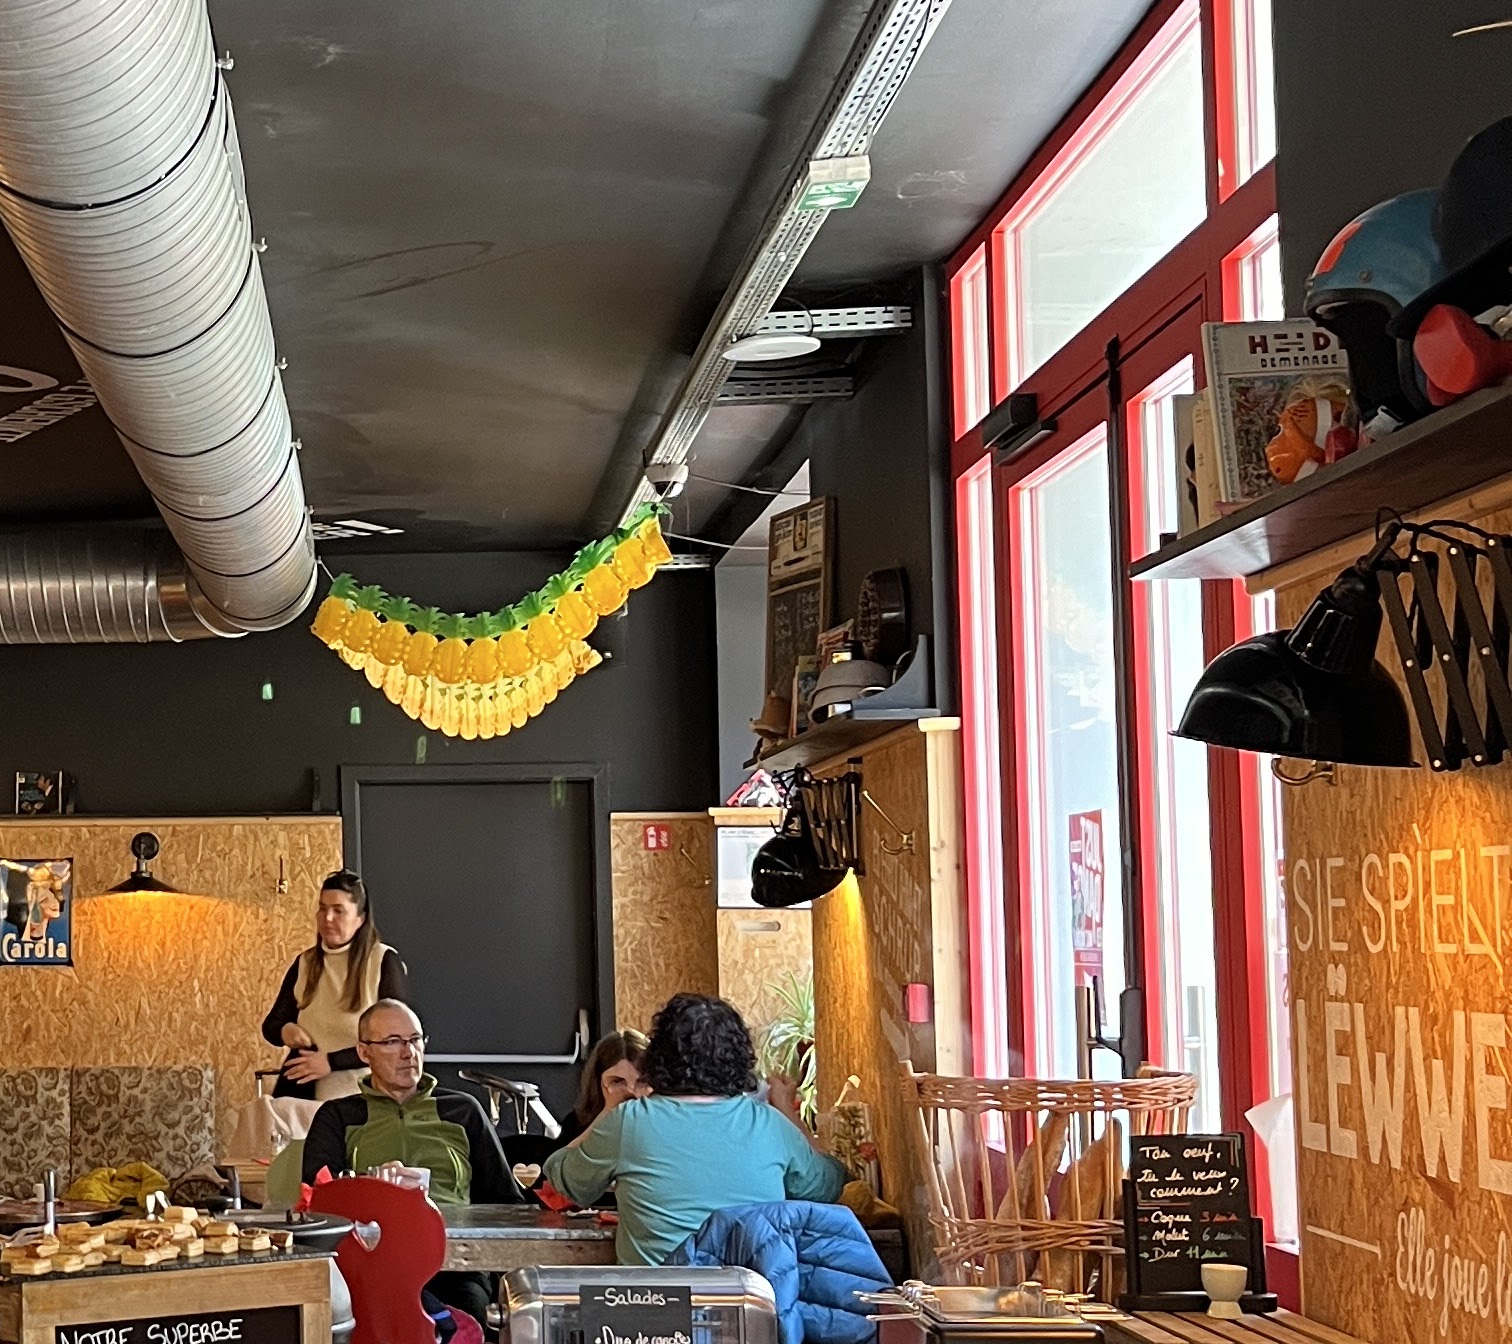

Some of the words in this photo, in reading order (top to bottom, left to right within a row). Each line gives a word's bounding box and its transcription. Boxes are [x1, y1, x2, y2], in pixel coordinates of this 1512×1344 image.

[2, 932, 67, 963] Carola
[1292, 856, 1349, 953] SIE
[1396, 1207, 1438, 1301] Elle
[1439, 1234, 1492, 1338] joue
